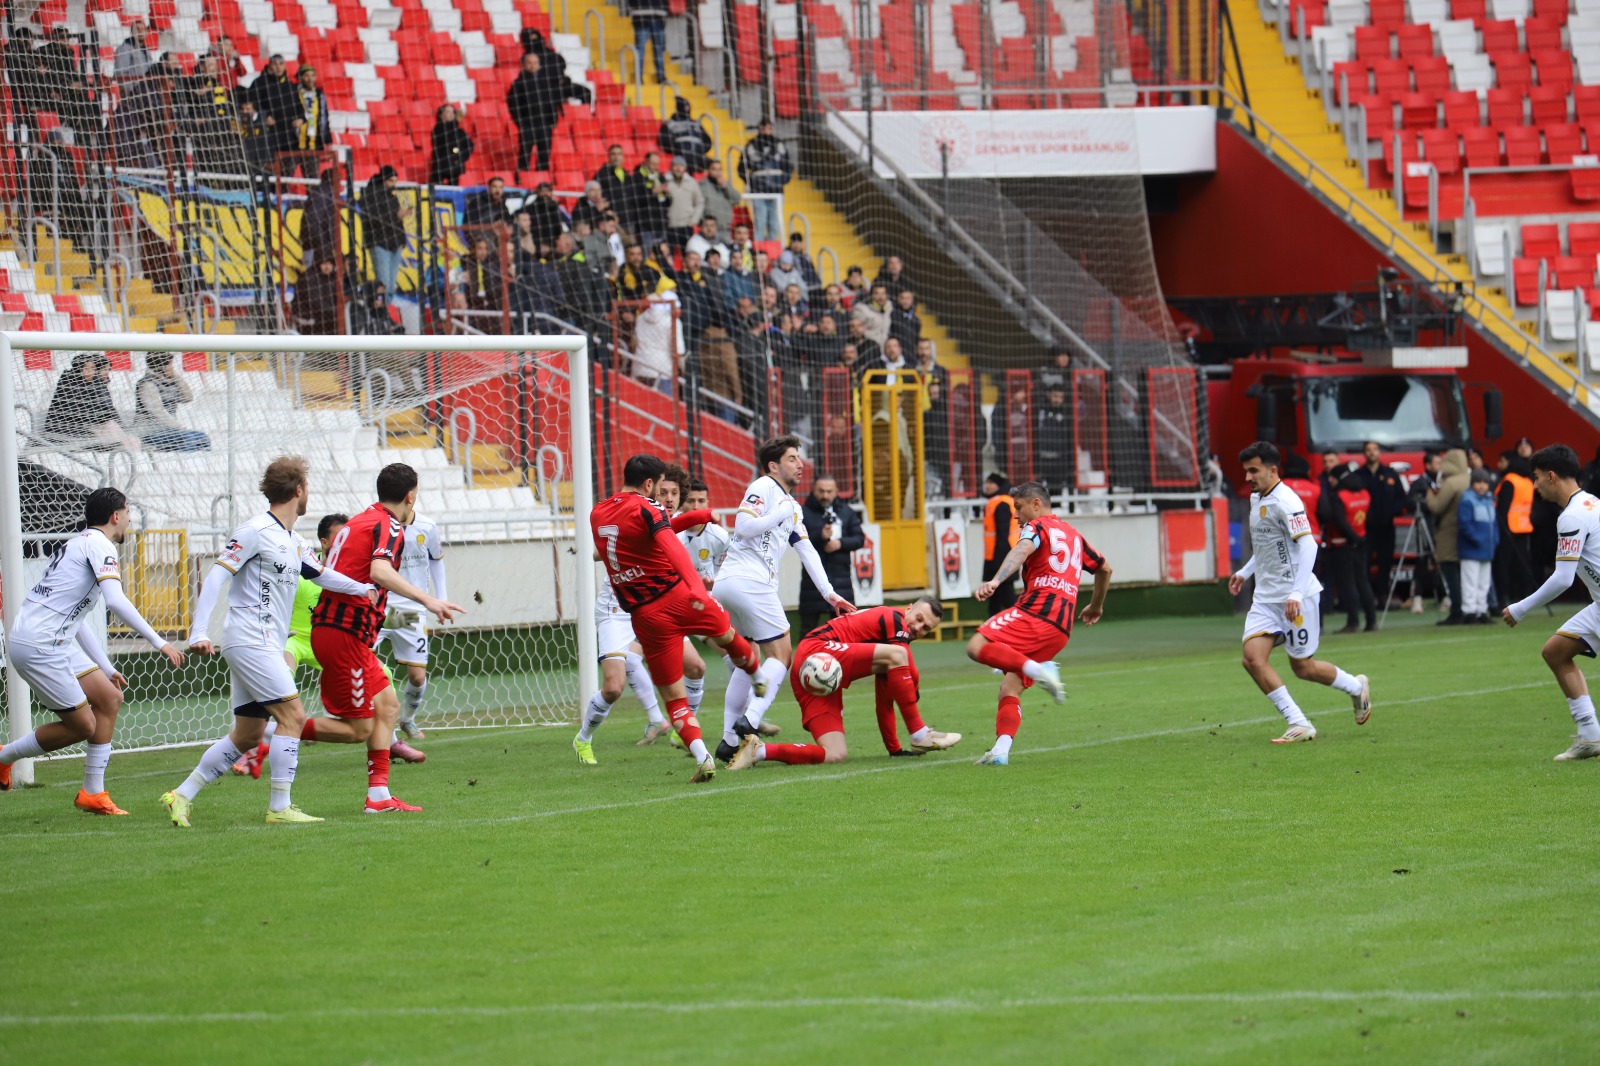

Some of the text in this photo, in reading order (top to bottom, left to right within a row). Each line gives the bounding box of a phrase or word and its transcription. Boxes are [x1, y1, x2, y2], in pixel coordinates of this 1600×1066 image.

[1023, 145, 1037, 155] VE
[1040, 144, 1069, 154] SPOR
[325, 526, 350, 570] 8
[598, 524, 619, 571] 7
[1048, 527, 1082, 579] 54
[1276, 541, 1289, 565] ASTOR
[71, 597, 92, 621] ASTOR
[416, 638, 426, 653] 2
[1287, 628, 1308, 646] 19
